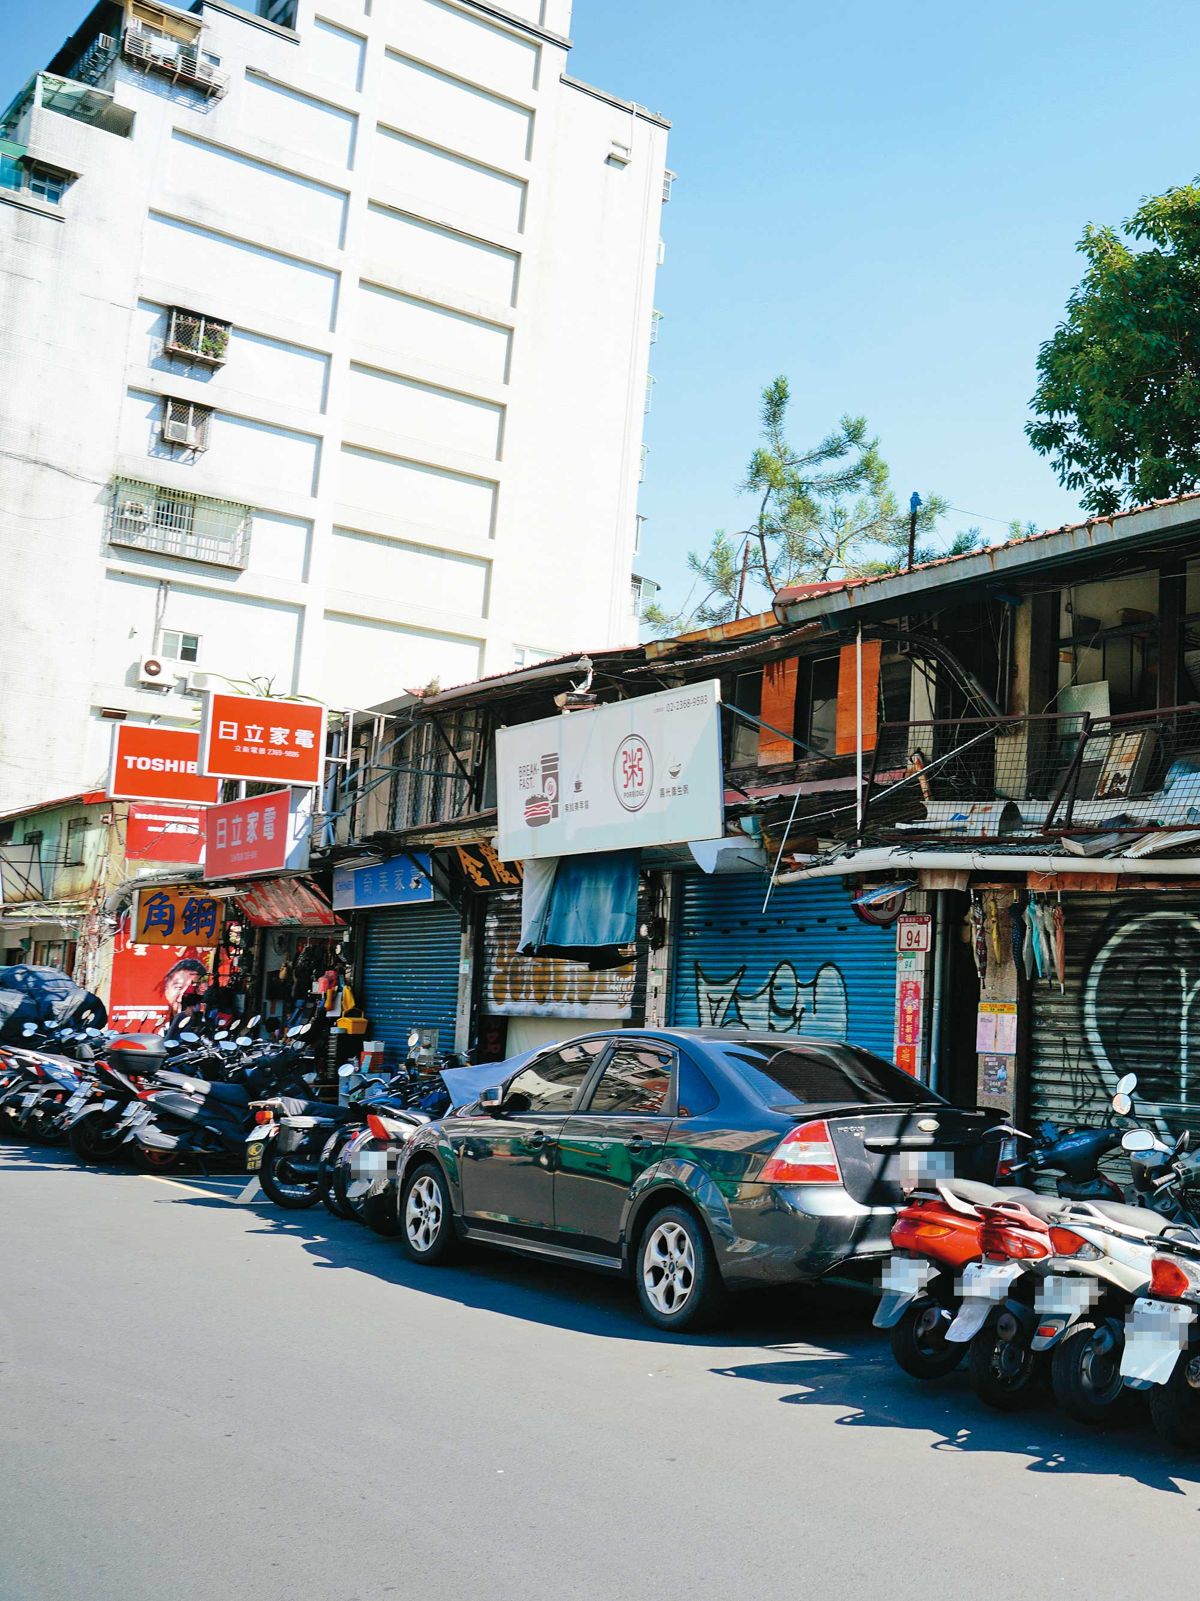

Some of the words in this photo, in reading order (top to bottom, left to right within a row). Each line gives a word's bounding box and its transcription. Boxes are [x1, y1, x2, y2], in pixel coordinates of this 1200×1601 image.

[218, 720, 315, 749] 日立家電
[123, 755, 199, 775] TOSHIB
[622, 747, 644, 789] 粥
[215, 806, 277, 850] 日立家電
[143, 891, 218, 939] 角鋼
[906, 930, 921, 948] 94
